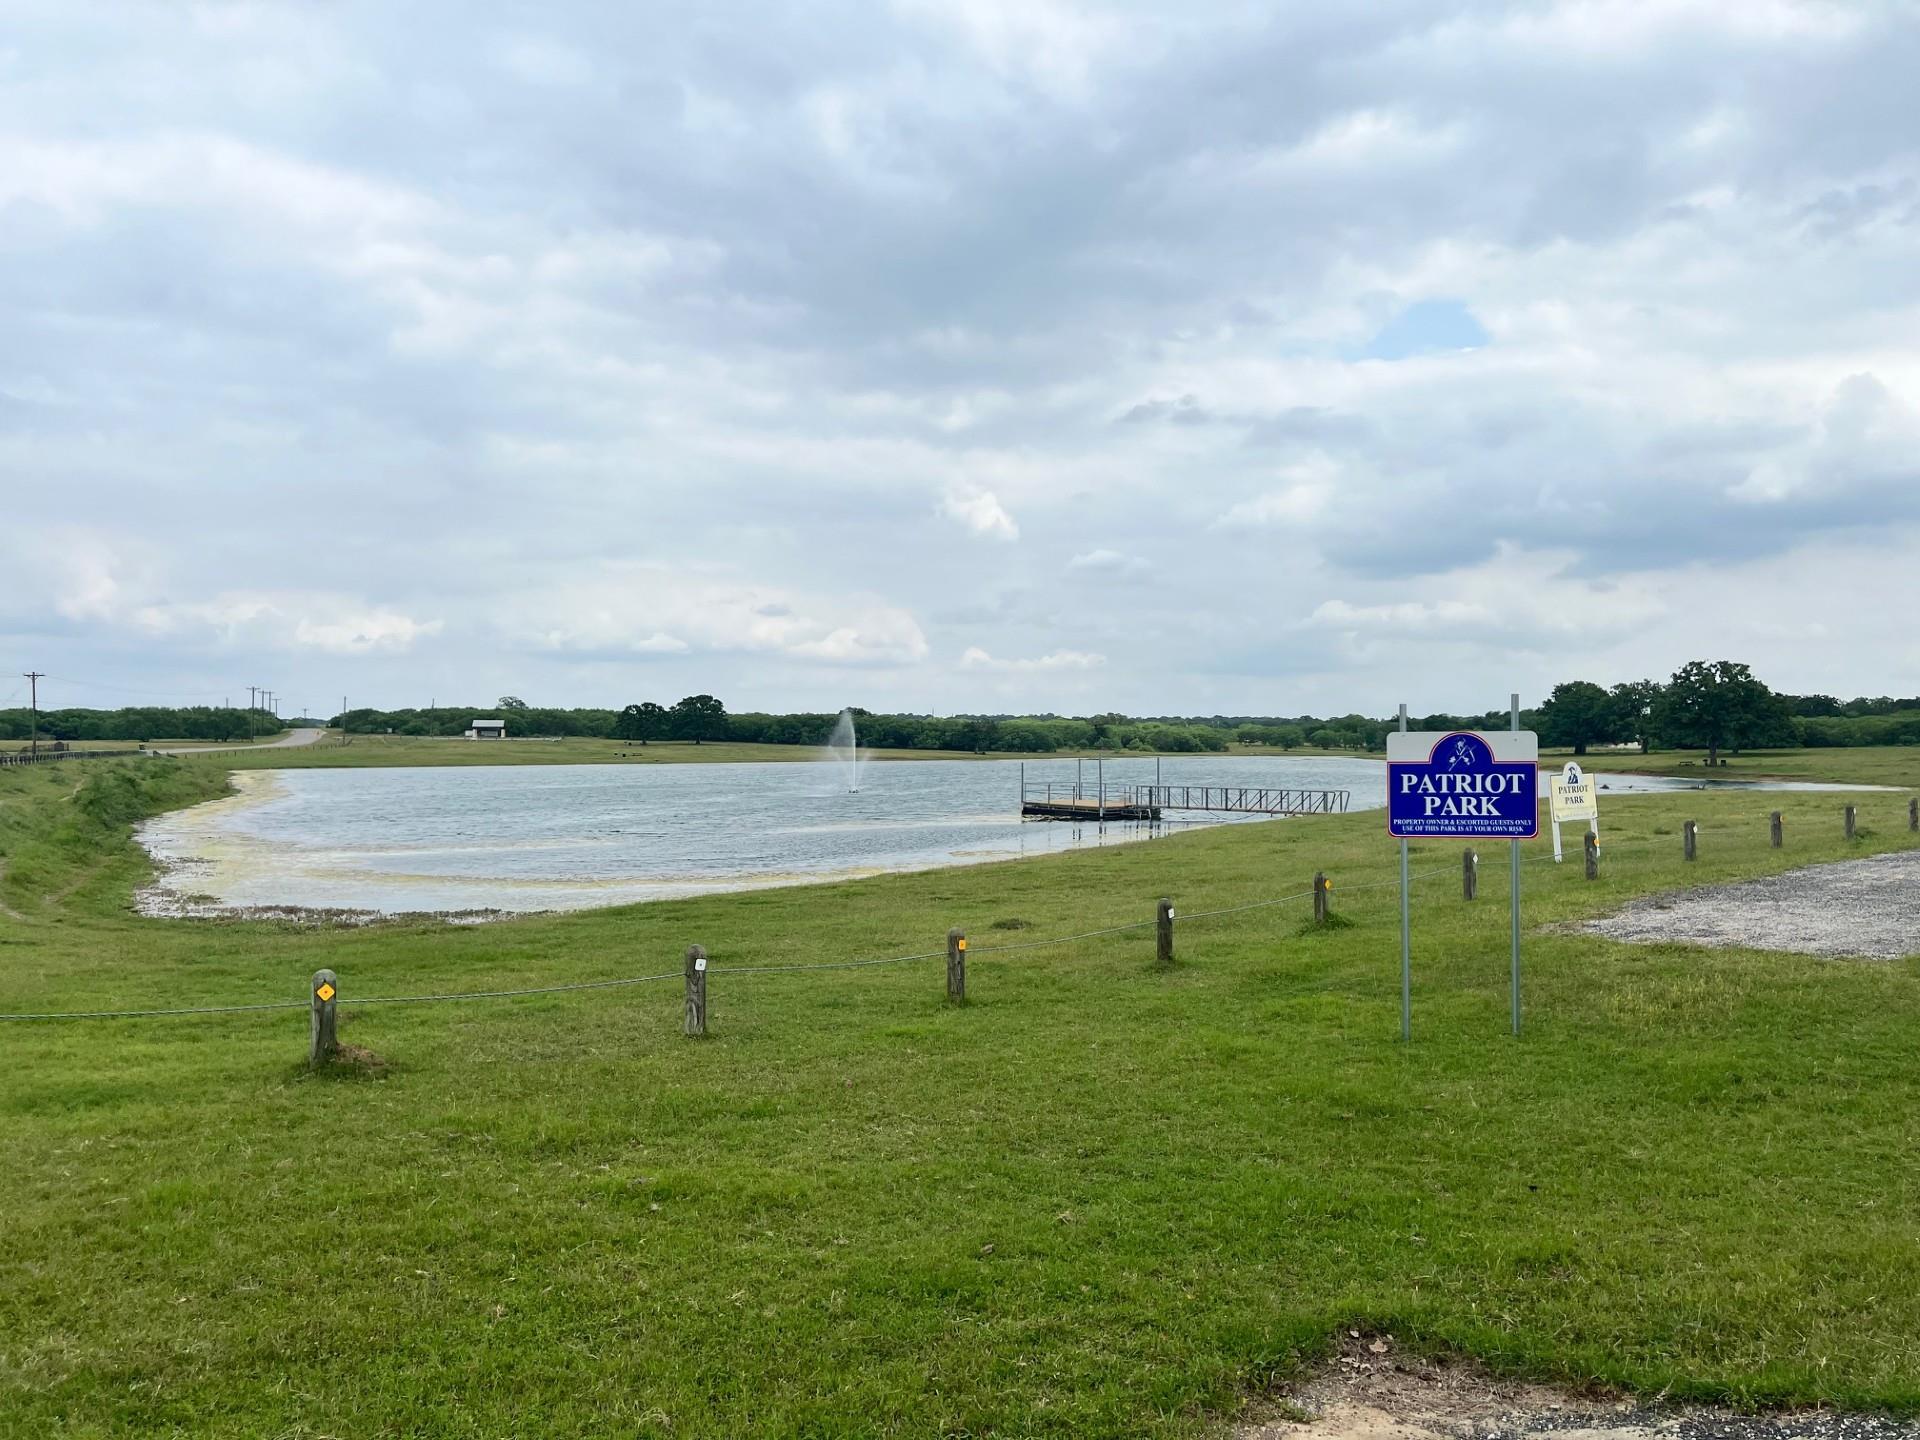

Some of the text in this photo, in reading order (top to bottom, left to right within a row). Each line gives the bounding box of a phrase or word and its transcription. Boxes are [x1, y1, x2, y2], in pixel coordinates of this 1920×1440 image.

[1400, 773, 1525, 794] PATRIOT
[1558, 784, 1588, 794] PATRIOT
[1423, 796, 1502, 816] PARK
[1565, 796, 1584, 804] PARK
